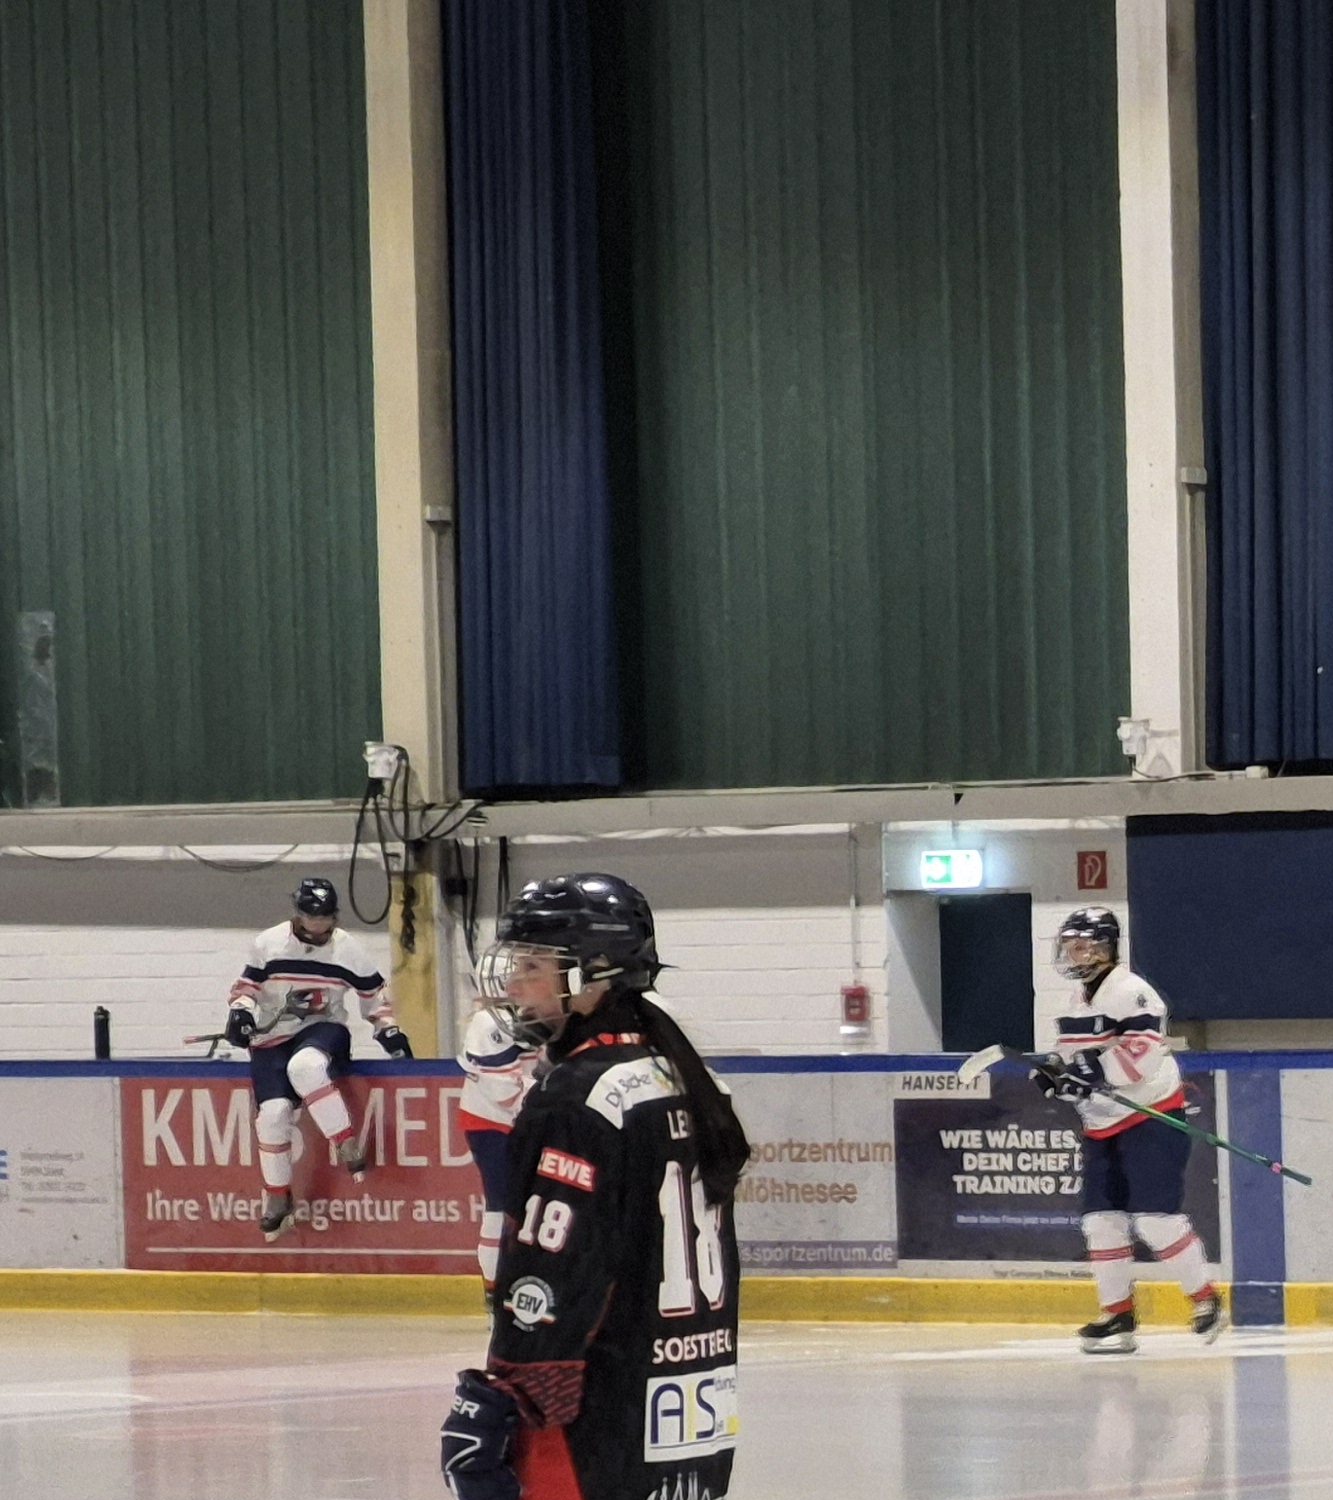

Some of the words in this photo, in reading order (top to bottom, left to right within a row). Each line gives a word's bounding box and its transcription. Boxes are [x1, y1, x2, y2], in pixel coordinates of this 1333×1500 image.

[141, 1088, 303, 1167] KM
[940, 1130, 982, 1149] WIE
[985, 1124, 1044, 1149] WÄRE
[1049, 1130, 1083, 1153] ES,
[963, 1153, 1013, 1172] DEIN
[1017, 1152, 1069, 1172] CHEF
[953, 1175, 1055, 1196] TRAINING
[146, 1190, 200, 1221] Ihre
[207, 1193, 404, 1231] Weragentur
[412, 1199, 460, 1221] aus
[518, 1194, 578, 1252] 18
[515, 1291, 546, 1316] EHV
